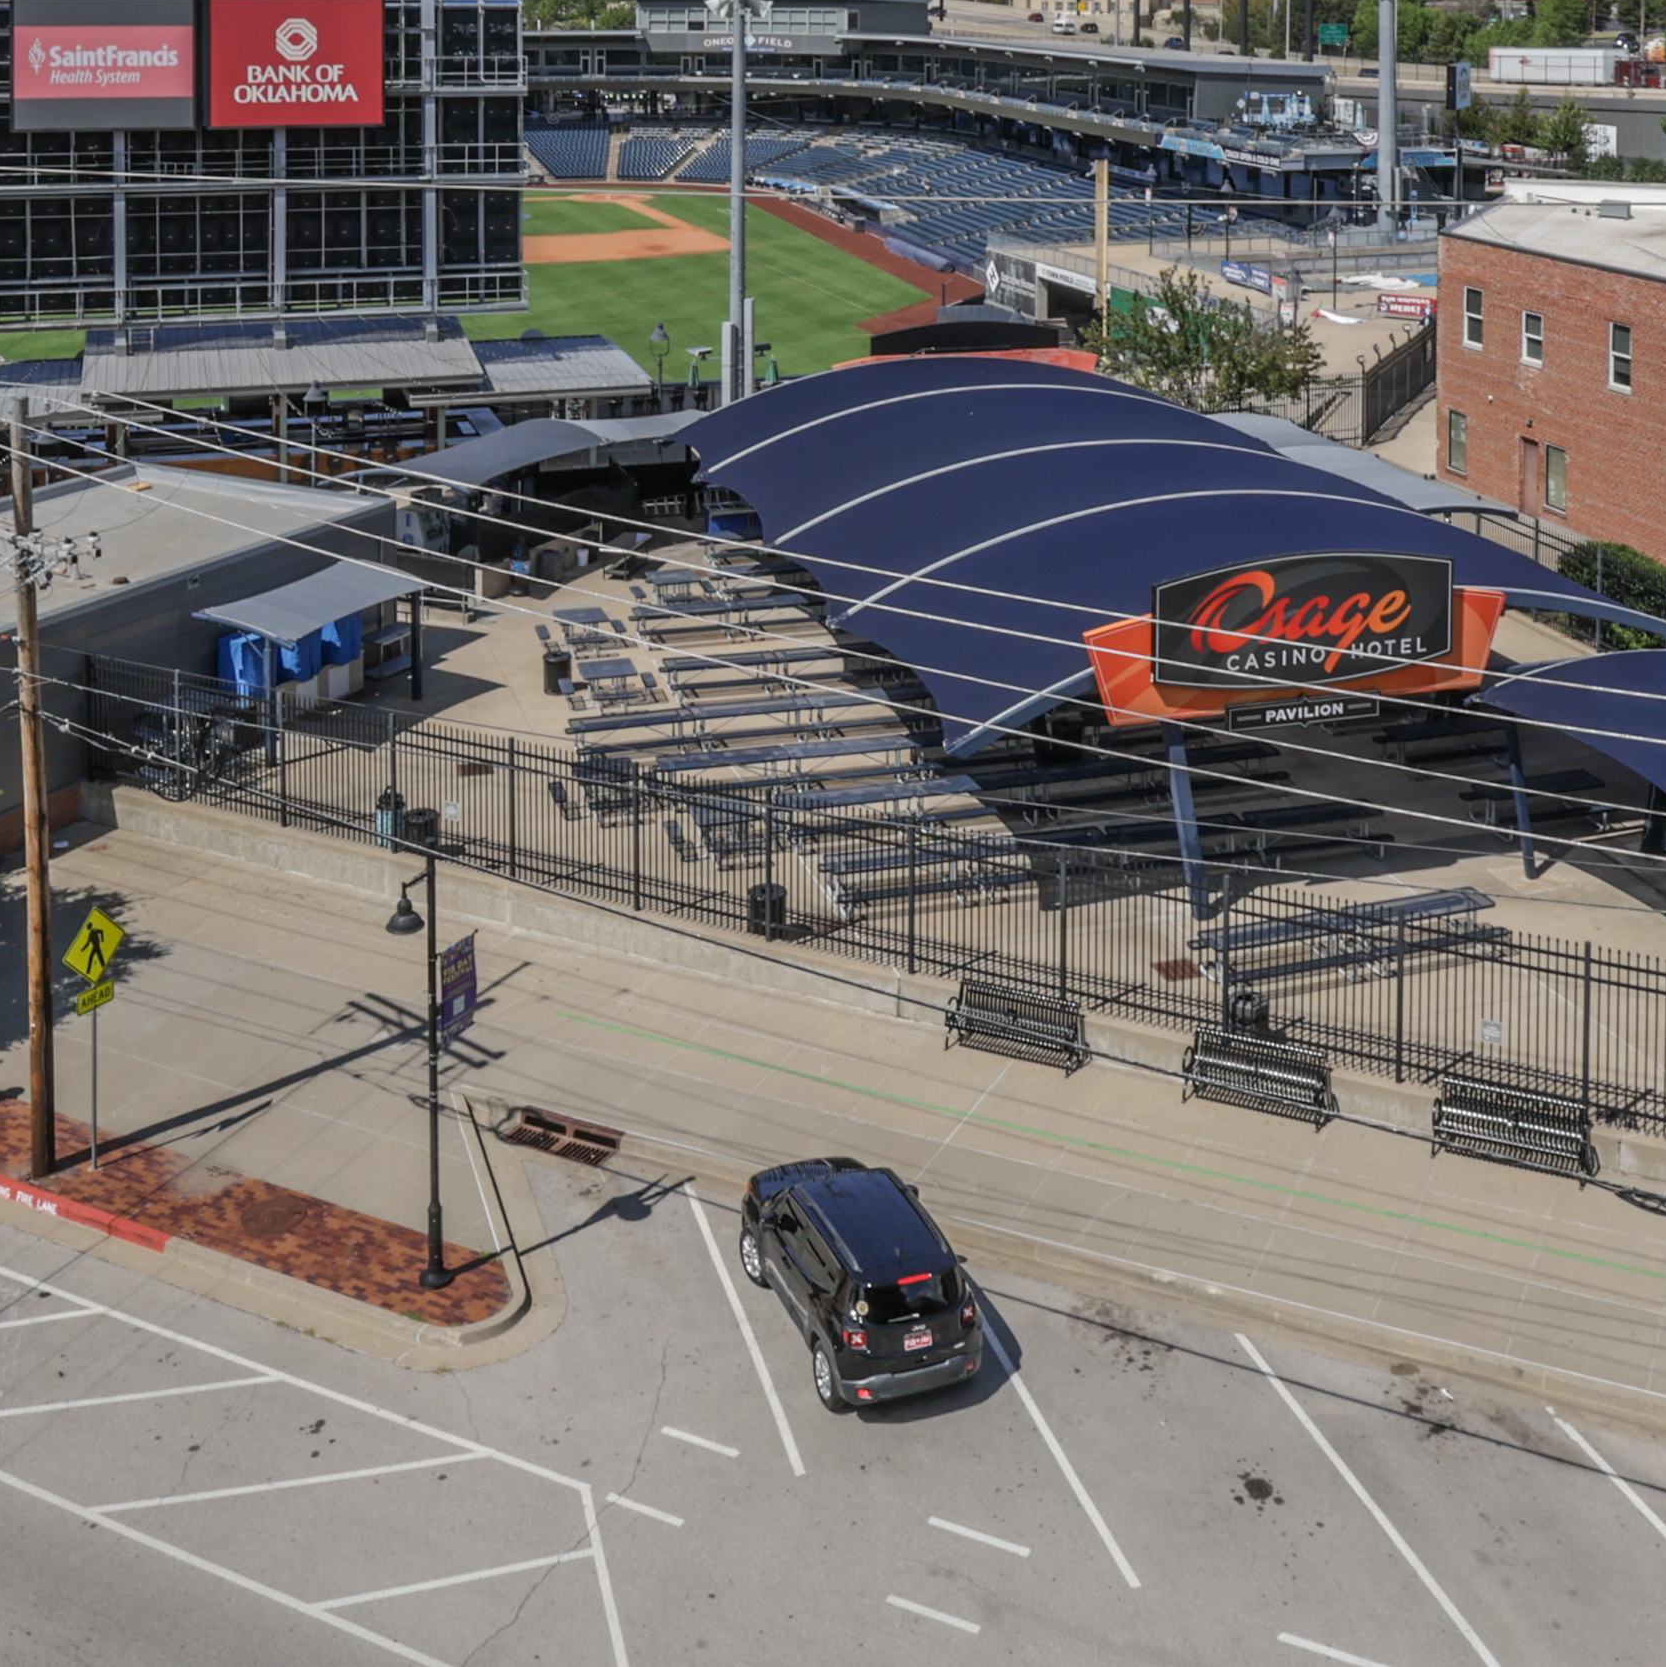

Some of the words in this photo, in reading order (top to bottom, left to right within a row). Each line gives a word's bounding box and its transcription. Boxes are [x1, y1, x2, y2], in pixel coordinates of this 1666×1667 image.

[703, 36, 734, 47] ONEO
[757, 36, 792, 48] FIELD
[49, 44, 179, 68] SaintFrancis
[49, 69, 93, 84] Health
[95, 69, 141, 87] System
[247, 65, 312, 83] BANK
[315, 64, 344, 83] OF
[233, 84, 359, 104] OKLAHOMA
[1390, 304, 1421, 314] HERE!
[1187, 570, 1412, 674] Osage
[1226, 647, 1326, 672] CASINO
[1351, 637, 1427, 660] HOTEL
[1266, 702, 1344, 723] PAVILION
[81, 986, 111, 1009] AHEAD
[15, 1190, 34, 1207] FIRE
[36, 1198, 58, 1216] LANE
